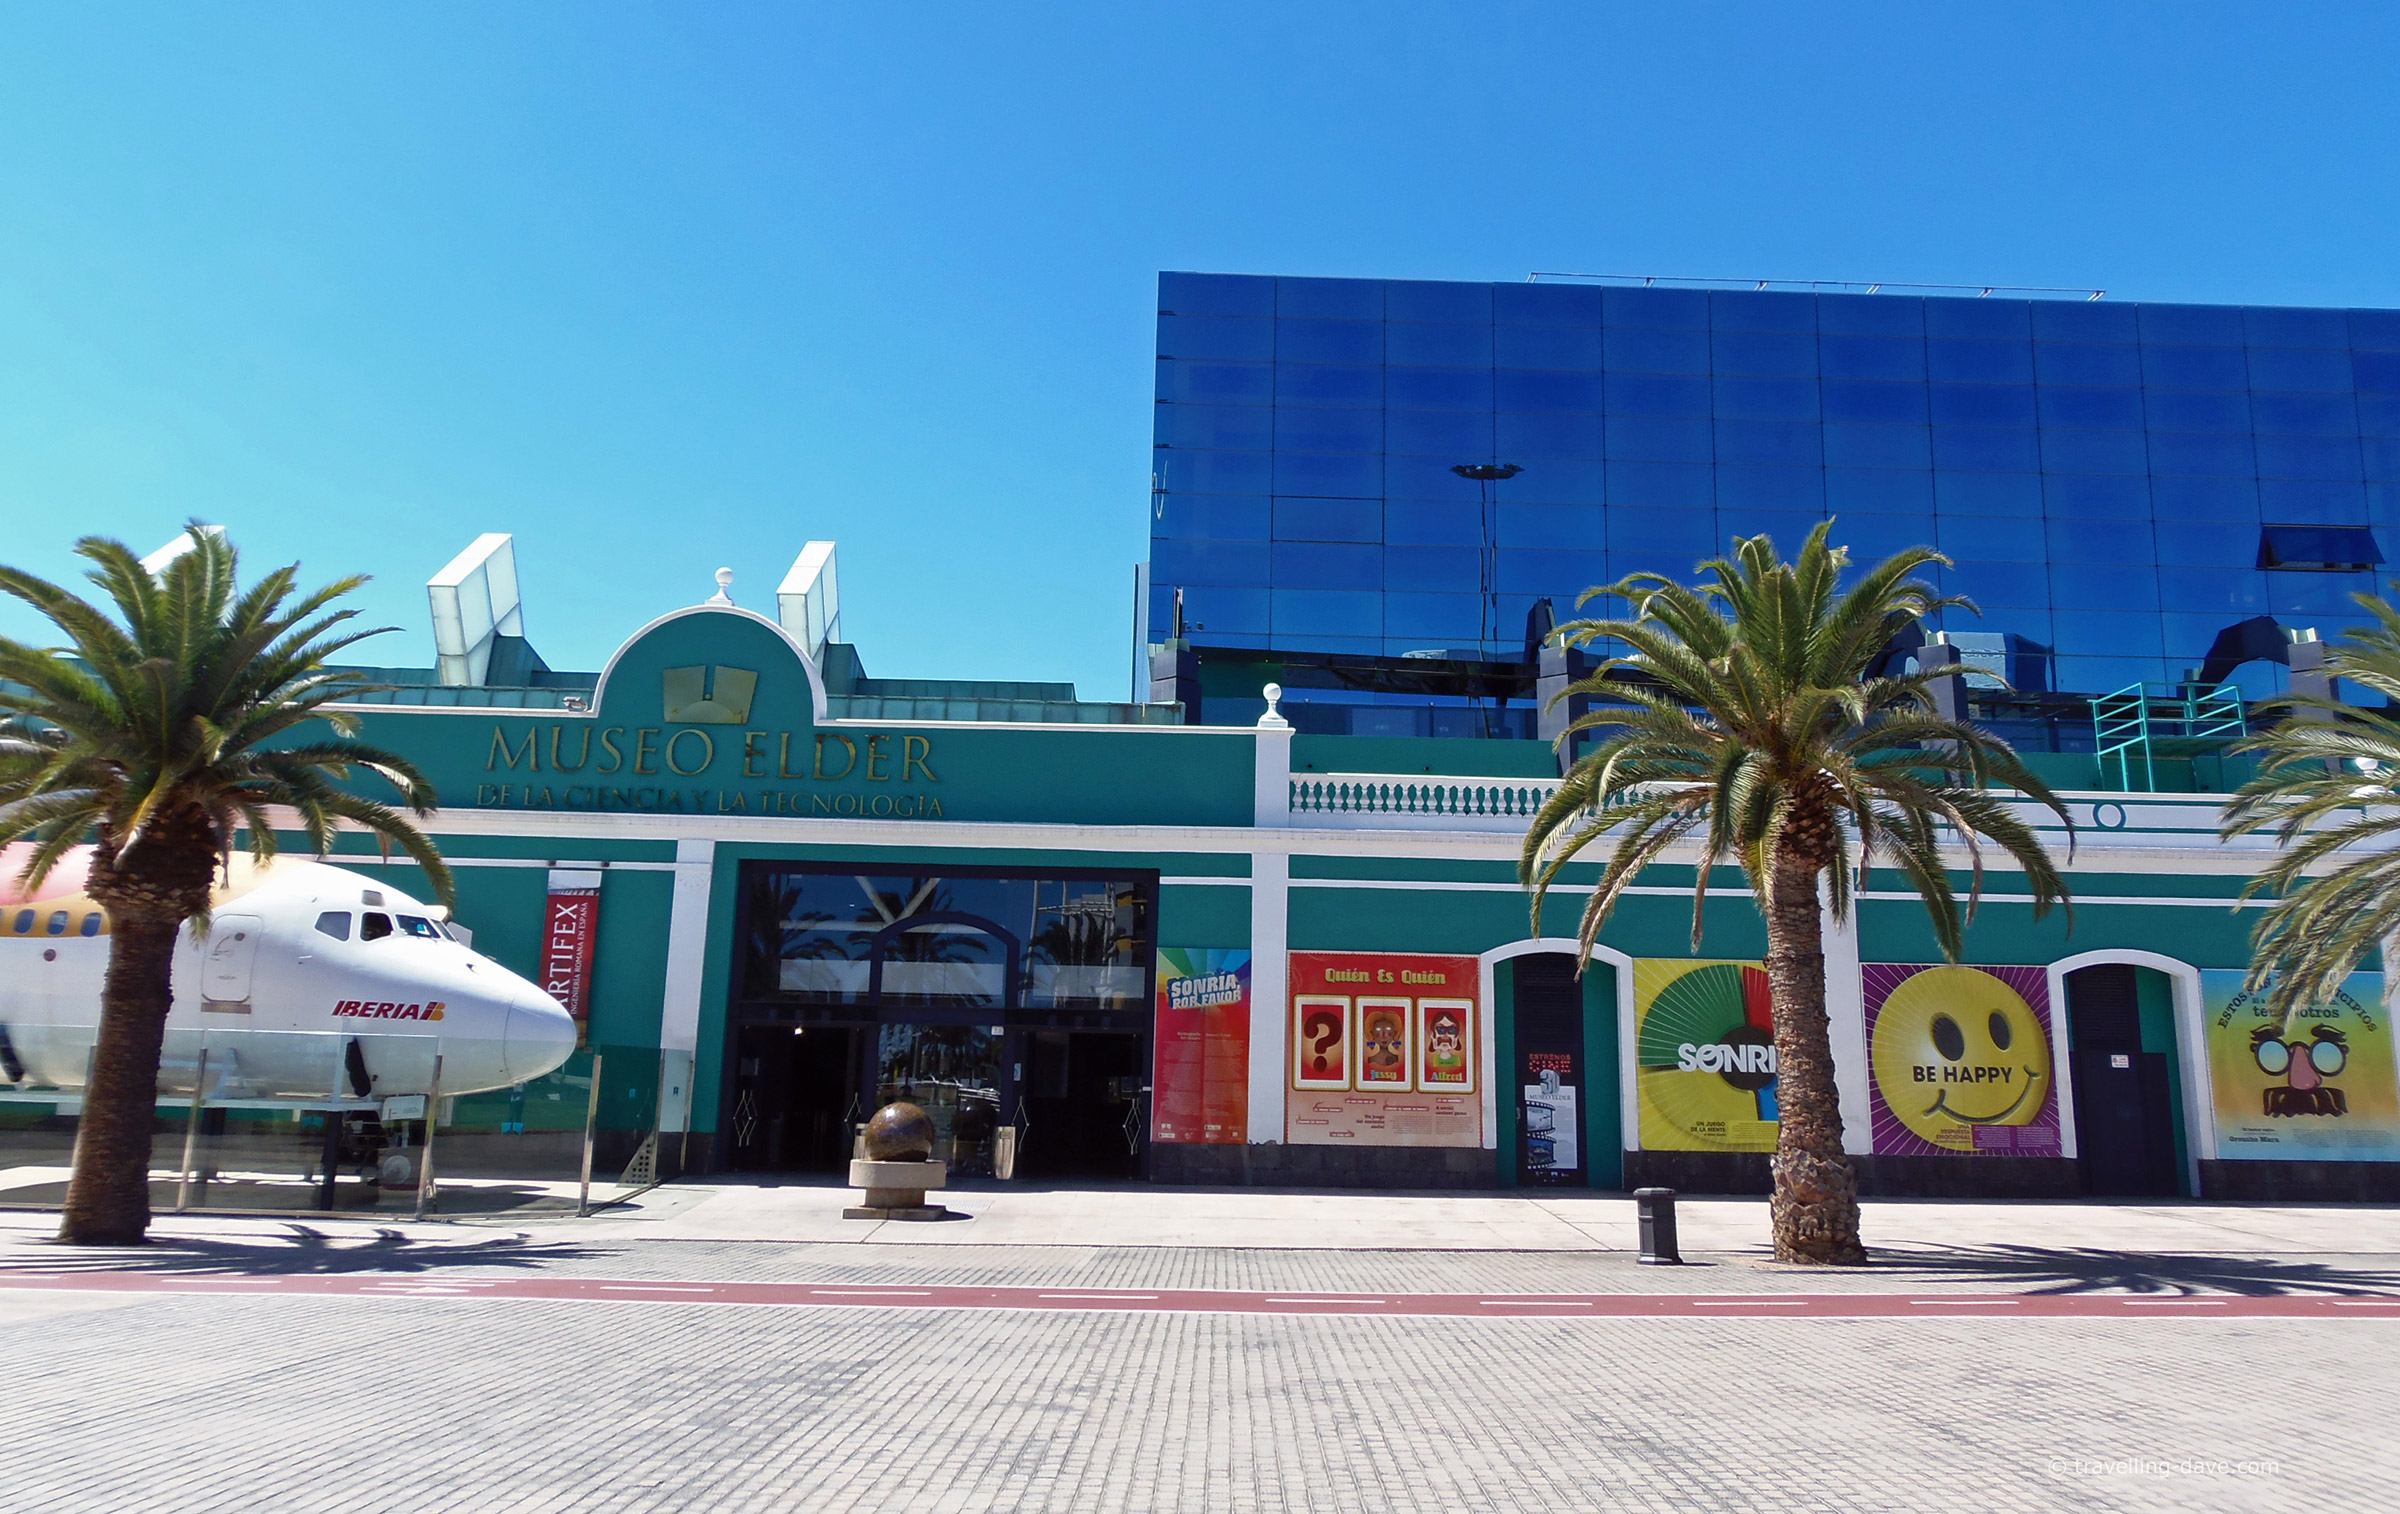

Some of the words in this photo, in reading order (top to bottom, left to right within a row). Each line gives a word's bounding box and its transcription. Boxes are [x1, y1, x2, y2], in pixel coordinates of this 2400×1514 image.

[486, 726, 714, 775] MUSEO
[743, 732, 937, 781] ELDER
[477, 784, 511, 806] DE
[524, 785, 552, 807] LA
[563, 786, 682, 811] CIENCIA
[692, 789, 709, 811] Y
[718, 791, 746, 812] LA
[1325, 968, 1370, 984] Quién
[1377, 969, 1395, 983] Es
[1401, 970, 1446, 985] Quién
[332, 1000, 419, 1019] IBERIA
[2217, 991, 2248, 1030] ESTOS
[2299, 1007, 2340, 1018] otros
[1678, 1043, 1777, 1073] SONRI
[1912, 1065, 1937, 1082] BE
[1944, 1066, 2013, 1083] HAPPY
